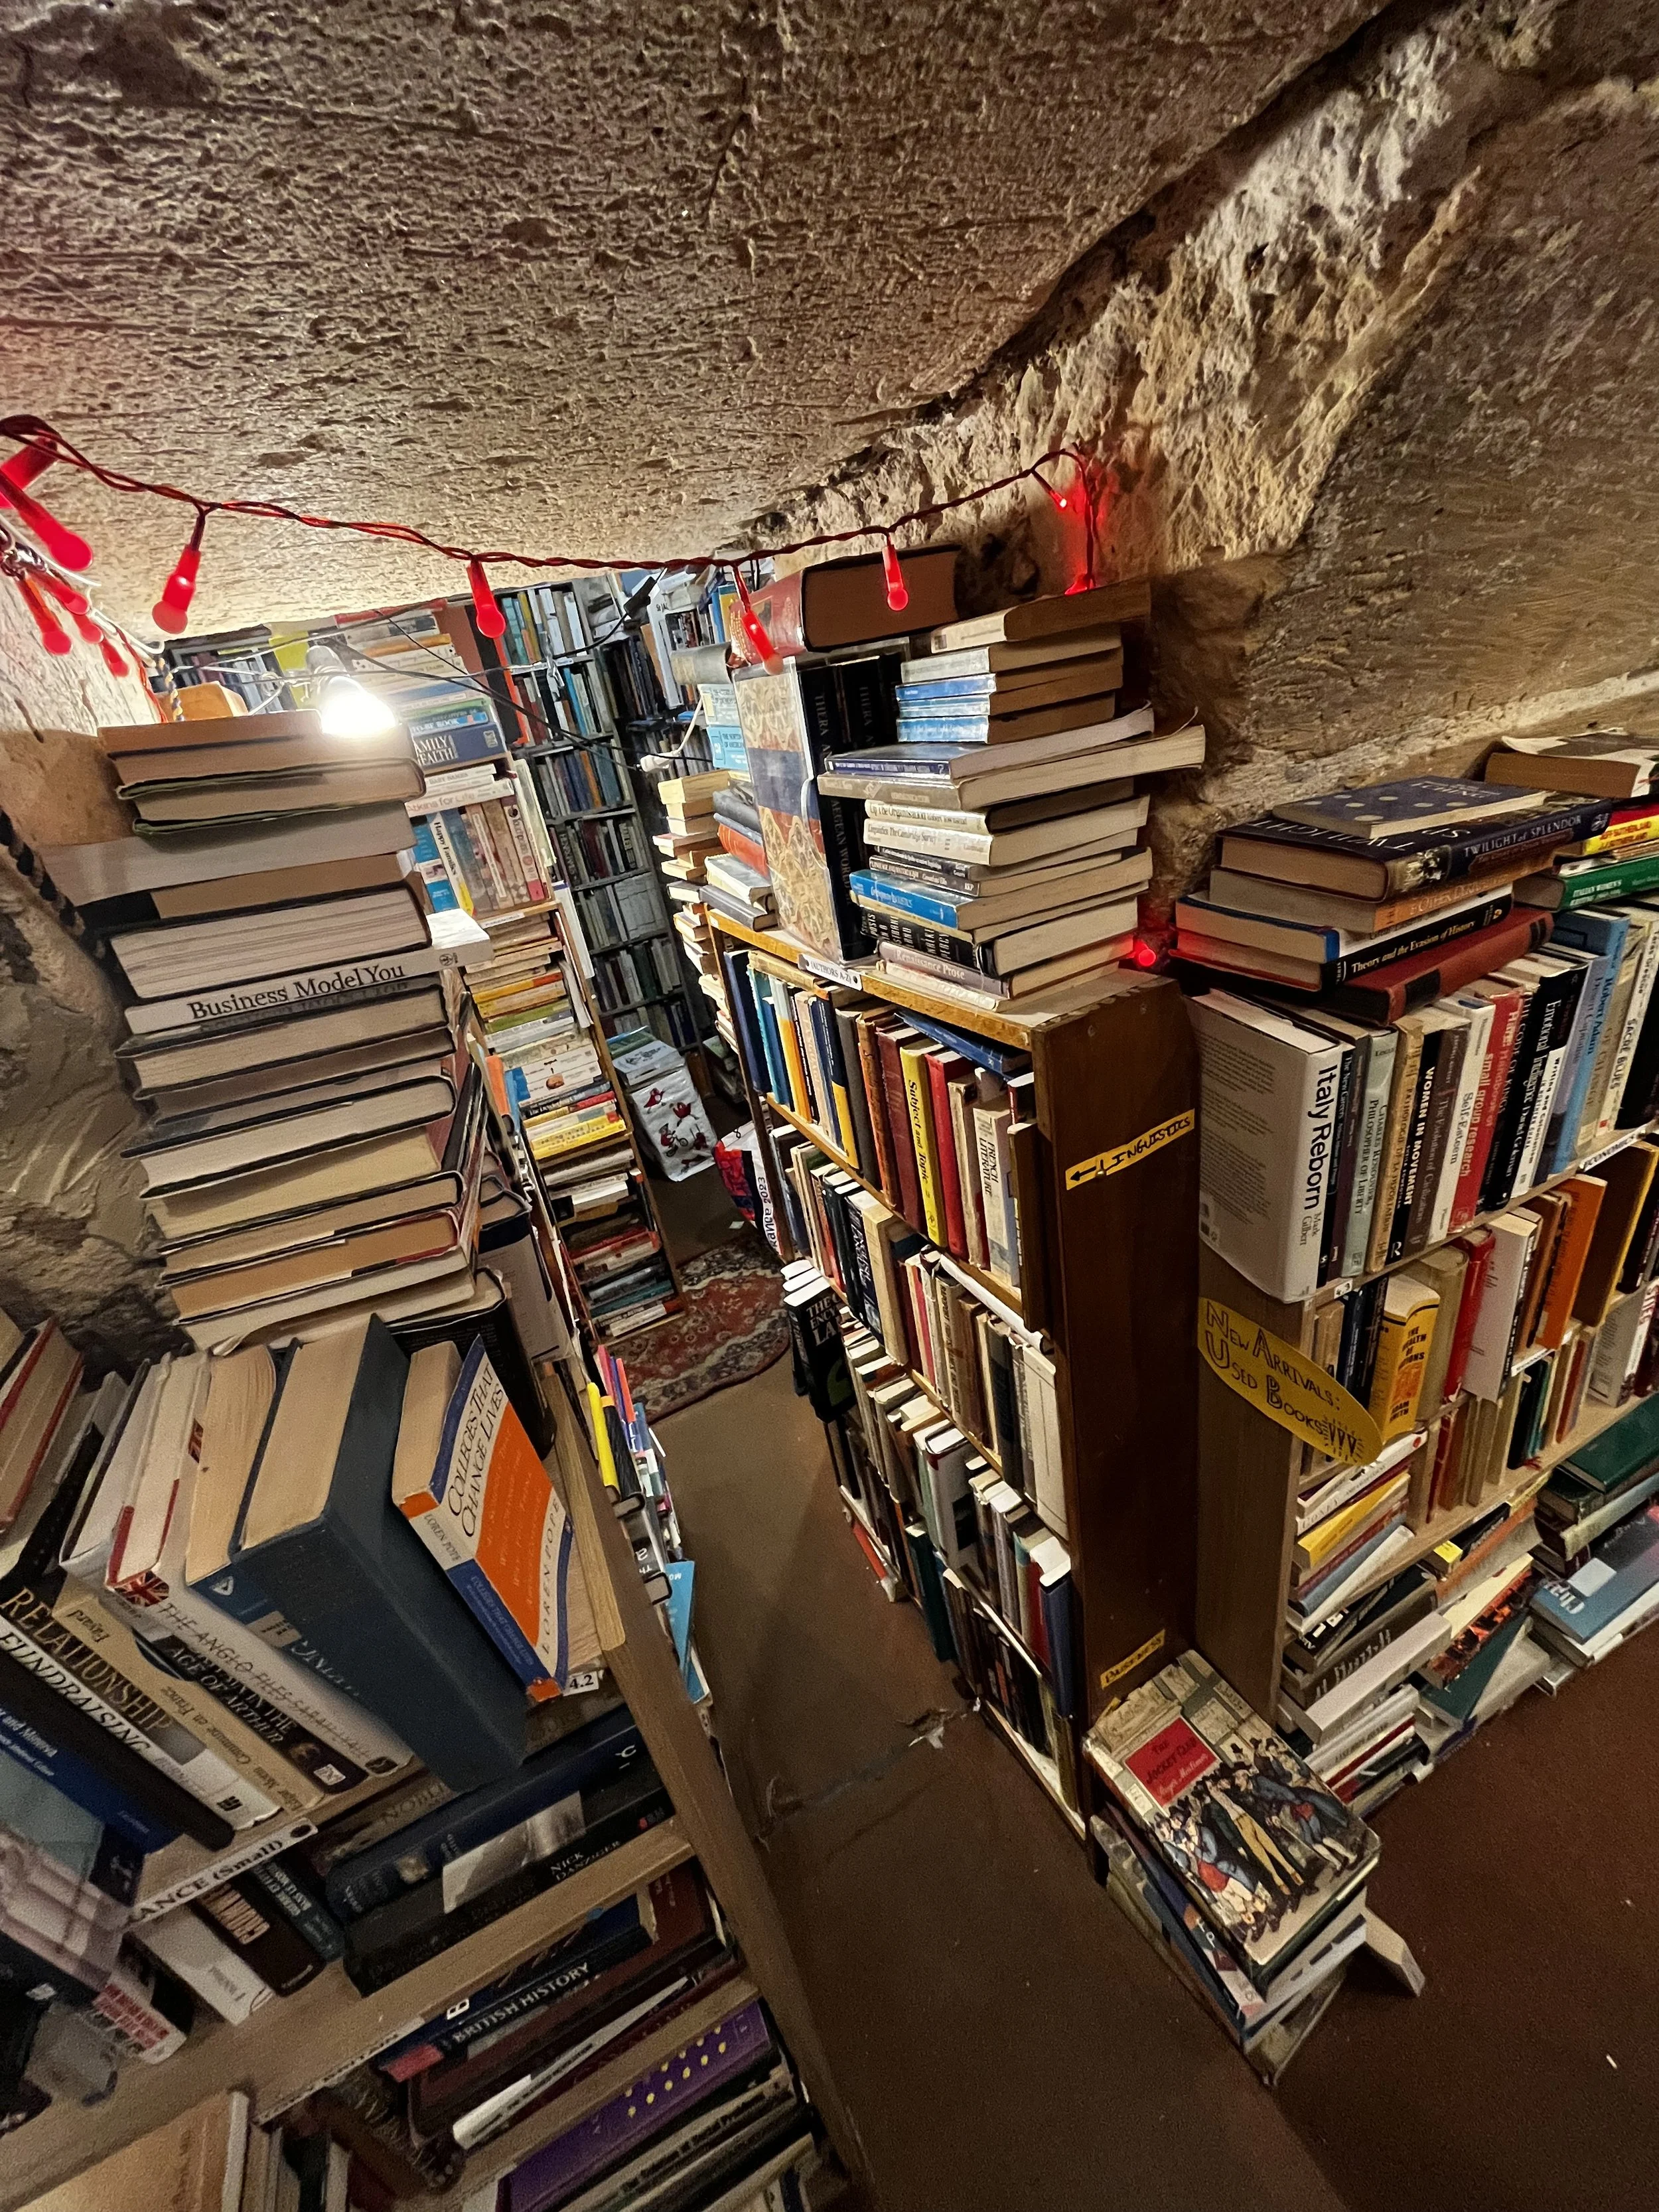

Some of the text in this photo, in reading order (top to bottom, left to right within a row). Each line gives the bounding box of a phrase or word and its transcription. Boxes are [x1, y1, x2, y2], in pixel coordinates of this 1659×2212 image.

[414, 734, 450, 753] AMILY
[433, 821, 445, 844] Happy
[1465, 833, 1518, 857] TWILIGHT
[1530, 815, 1582, 839] SPLENDOR
[895, 949, 966, 982] Renaissance Prose
[1351, 920, 1477, 974] Theory and the Evasion of History
[188, 985, 290, 1020] Business
[293, 968, 365, 999] Model
[364, 964, 407, 984] You
[1536, 1000, 1561, 1053] Emotional
[908, 1079, 929, 1185] Subject and Topic
[1304, 1064, 1338, 1212] Italy Reborn
[1403, 1066, 1435, 1206] WOMEN IN MOVEMENT
[1450, 1092, 1475, 1166] Self-Esteem
[1460, 1053, 1493, 1178] small group research
[1099, 1116, 1191, 1171] LINGUISTICS
[758, 1177, 772, 1205] 2023
[1354, 1180, 1368, 1215] LIBERTY
[1311, 1212, 1323, 1238] Mark
[806, 1299, 830, 1319] THE
[809, 1309, 839, 1329] ENCY
[812, 1323, 839, 1347] LA
[1205, 1329, 1258, 1390] USED
[1206, 1299, 1250, 1351] NEW
[1252, 1327, 1340, 1412] ARRIVALS:
[447, 1362, 494, 1518] COLLEGES THAT
[461, 1382, 506, 1538] CHANGE LIVES
[425, 1512, 447, 1543] LOREN
[542, 1498, 561, 1554] POPE
[0, 1584, 174, 1737] RELATIONSHIP
[159, 1601, 197, 1635] THE
[194, 1627, 254, 1676] ANGLO
[251, 1670, 293, 1704] FILES
[167, 1644, 286, 1746] AGE OF ARTHUR
[569, 1672, 594, 1690] 4.2
[210, 1836, 285, 1883] (Small)
[549, 1849, 584, 1874] NICK
[451, 1960, 591, 2043] BRITISH HISTORY
